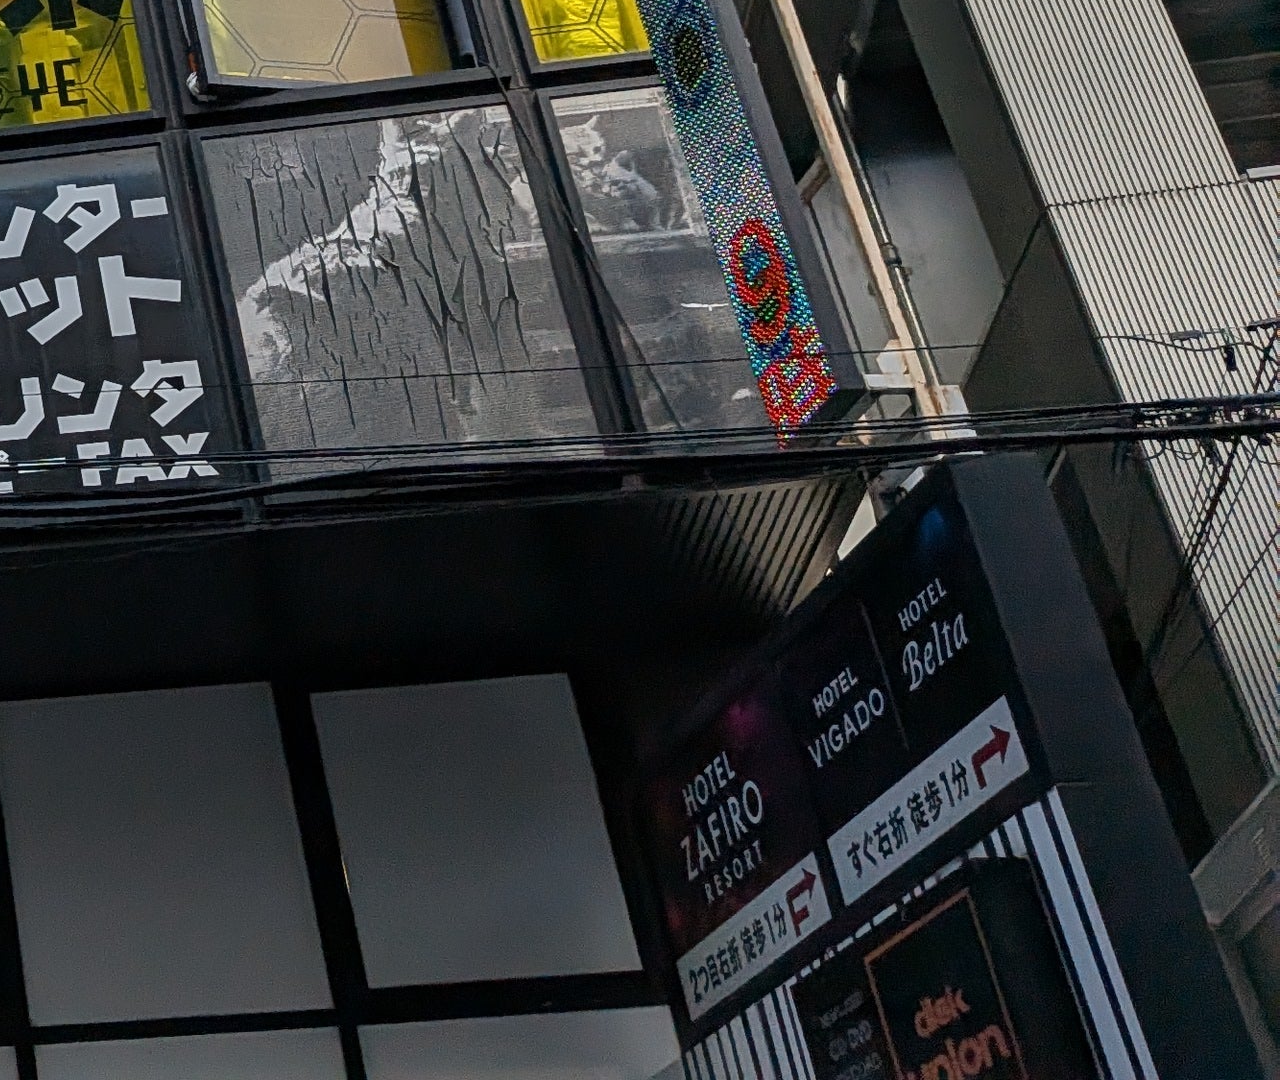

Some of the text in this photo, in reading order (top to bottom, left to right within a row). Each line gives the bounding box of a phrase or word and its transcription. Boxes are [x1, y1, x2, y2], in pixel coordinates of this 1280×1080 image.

[76, 432, 219, 487] FAX
[898, 577, 947, 631] HOTEL
[903, 612, 970, 692] Belta
[812, 667, 859, 718] HOTEL
[807, 688, 885, 768] VIGADO
[682, 751, 736, 817] HOTEL
[680, 780, 763, 881] ZAFIRO
[704, 840, 763, 905] RESORT
